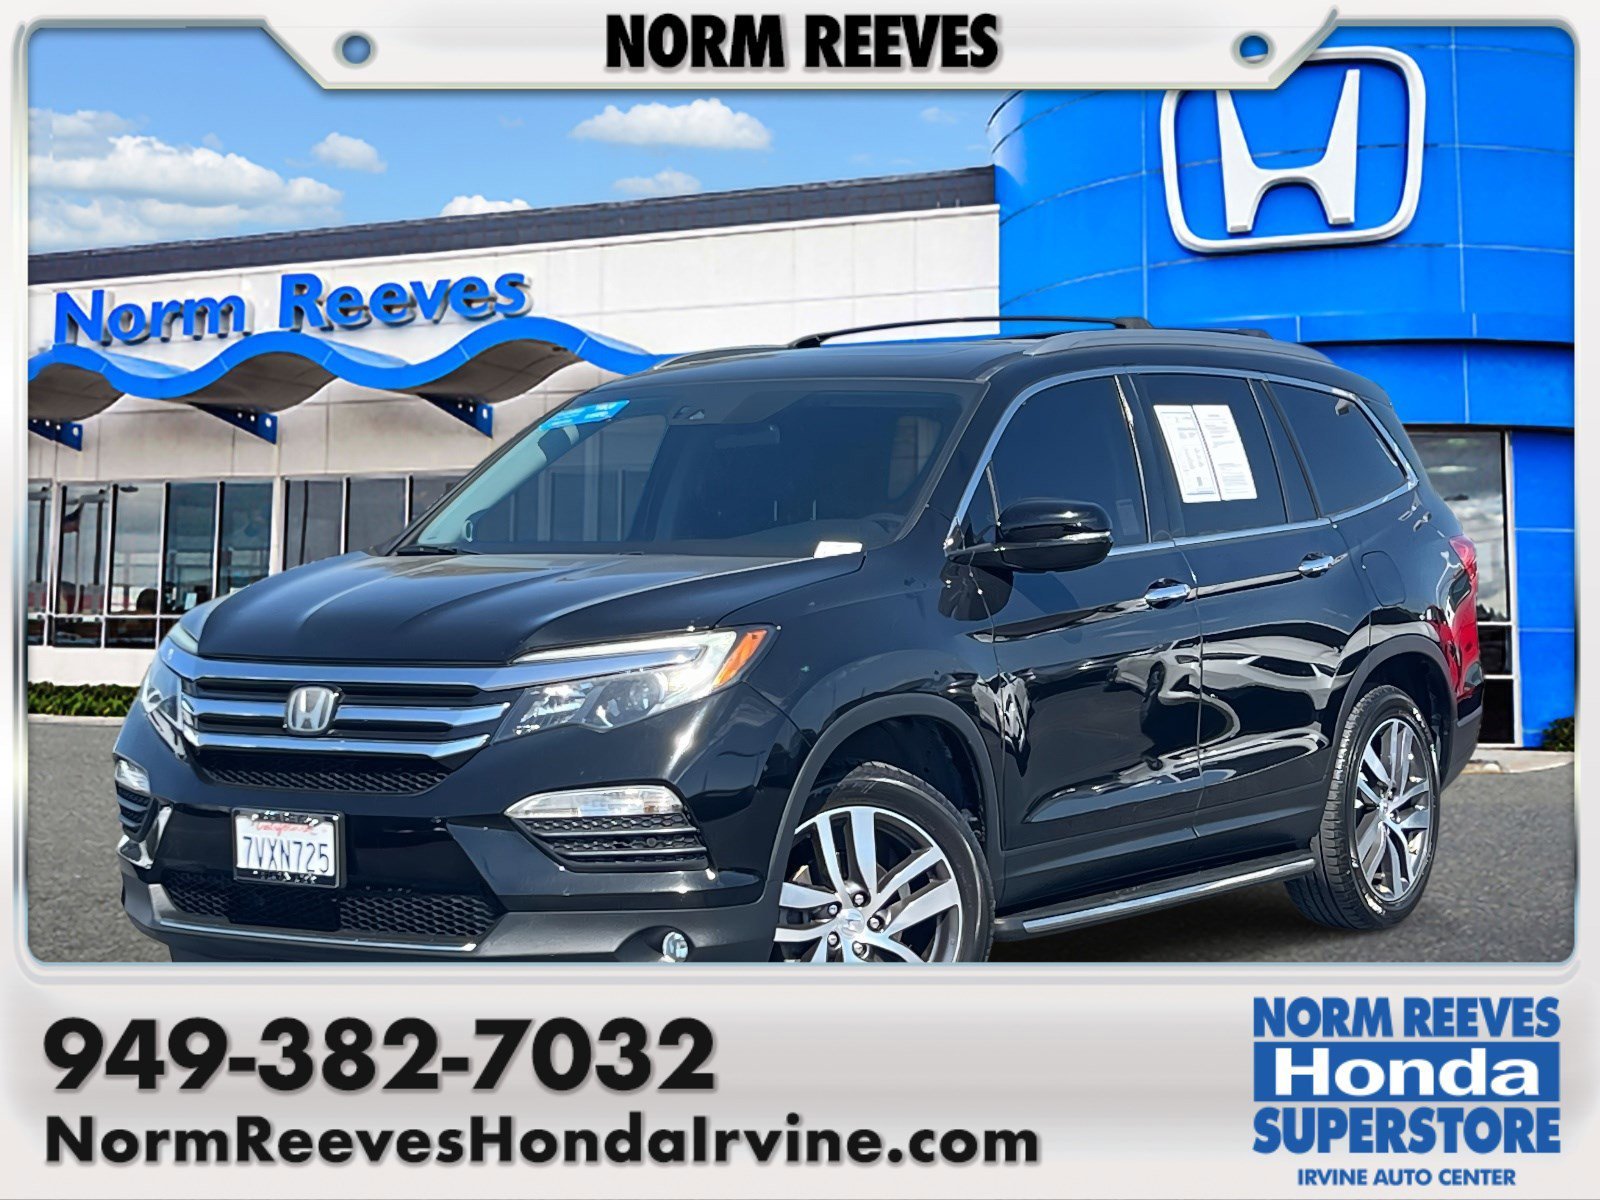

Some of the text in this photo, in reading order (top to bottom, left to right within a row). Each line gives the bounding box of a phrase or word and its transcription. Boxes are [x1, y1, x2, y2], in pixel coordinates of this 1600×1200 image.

[54, 272, 527, 345] Norm Reeves
[242, 835, 330, 874] 7VXN725
